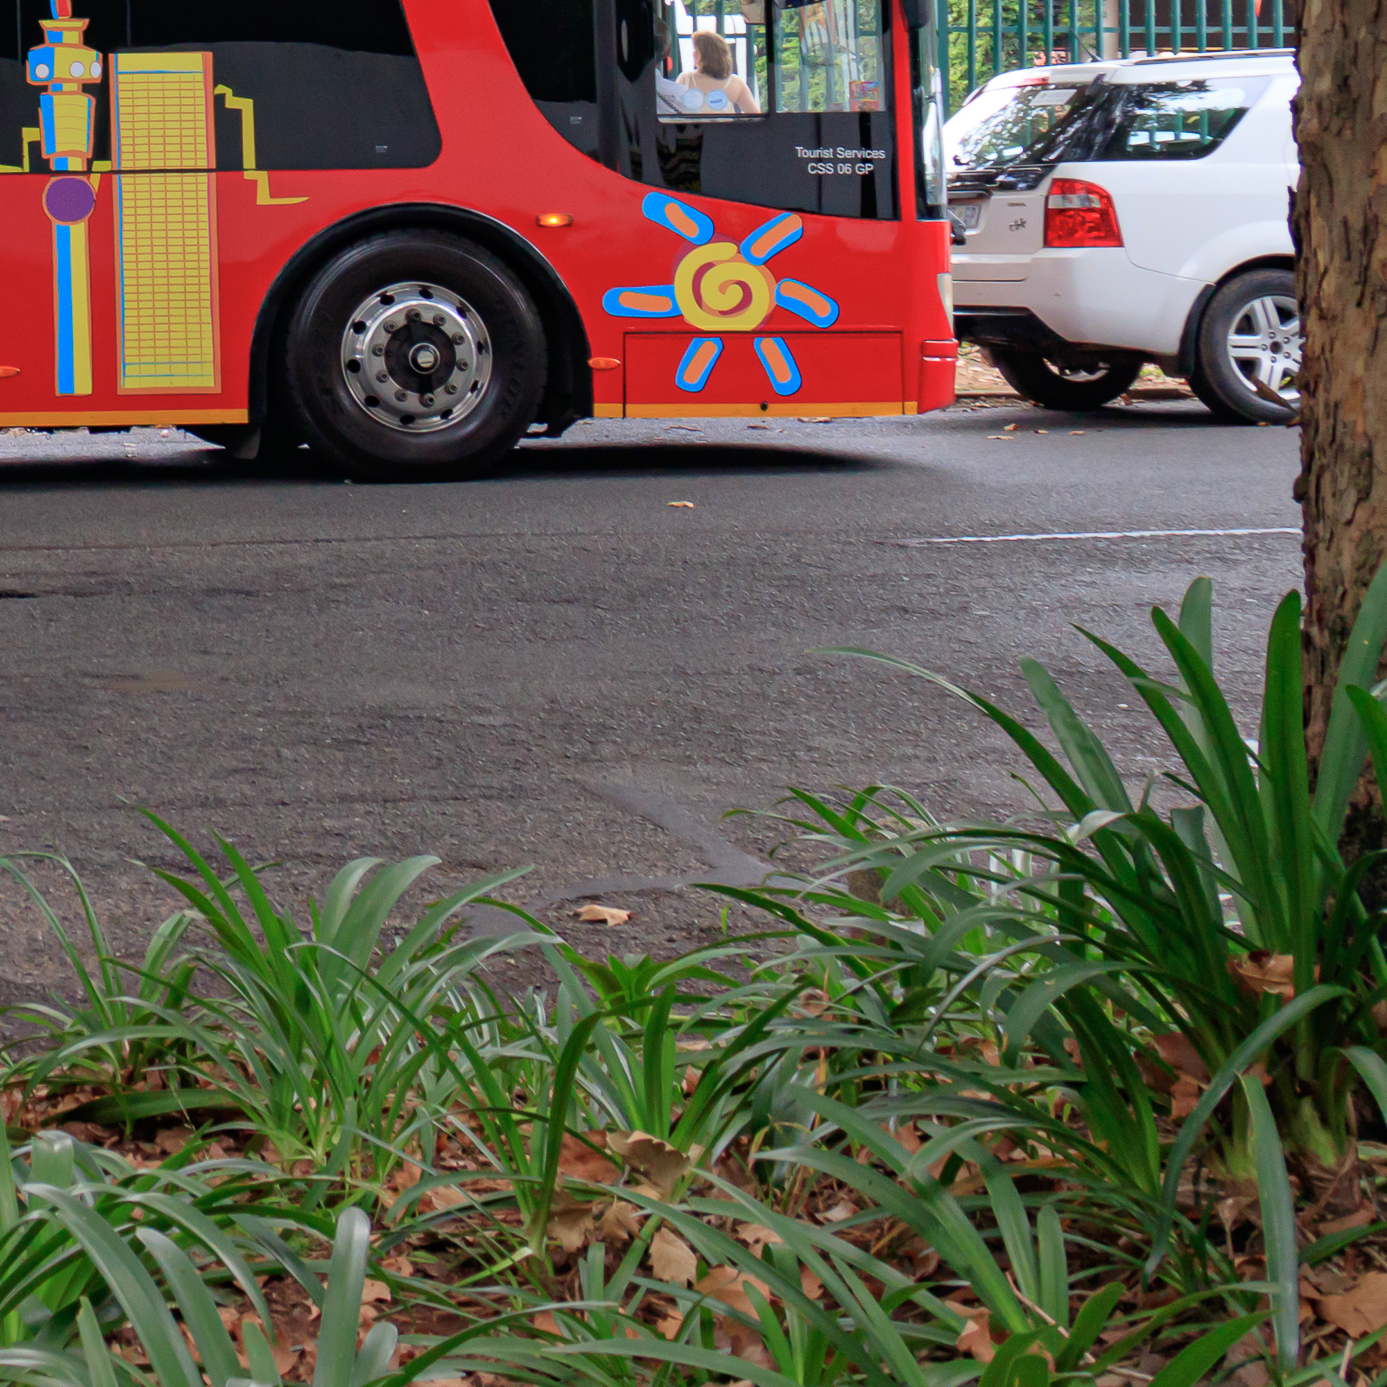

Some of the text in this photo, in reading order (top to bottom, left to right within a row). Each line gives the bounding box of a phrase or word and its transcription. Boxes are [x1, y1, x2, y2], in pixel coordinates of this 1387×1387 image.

[795, 146, 886, 159] Tourist Services
[807, 162, 874, 175] CSS 06 GP
